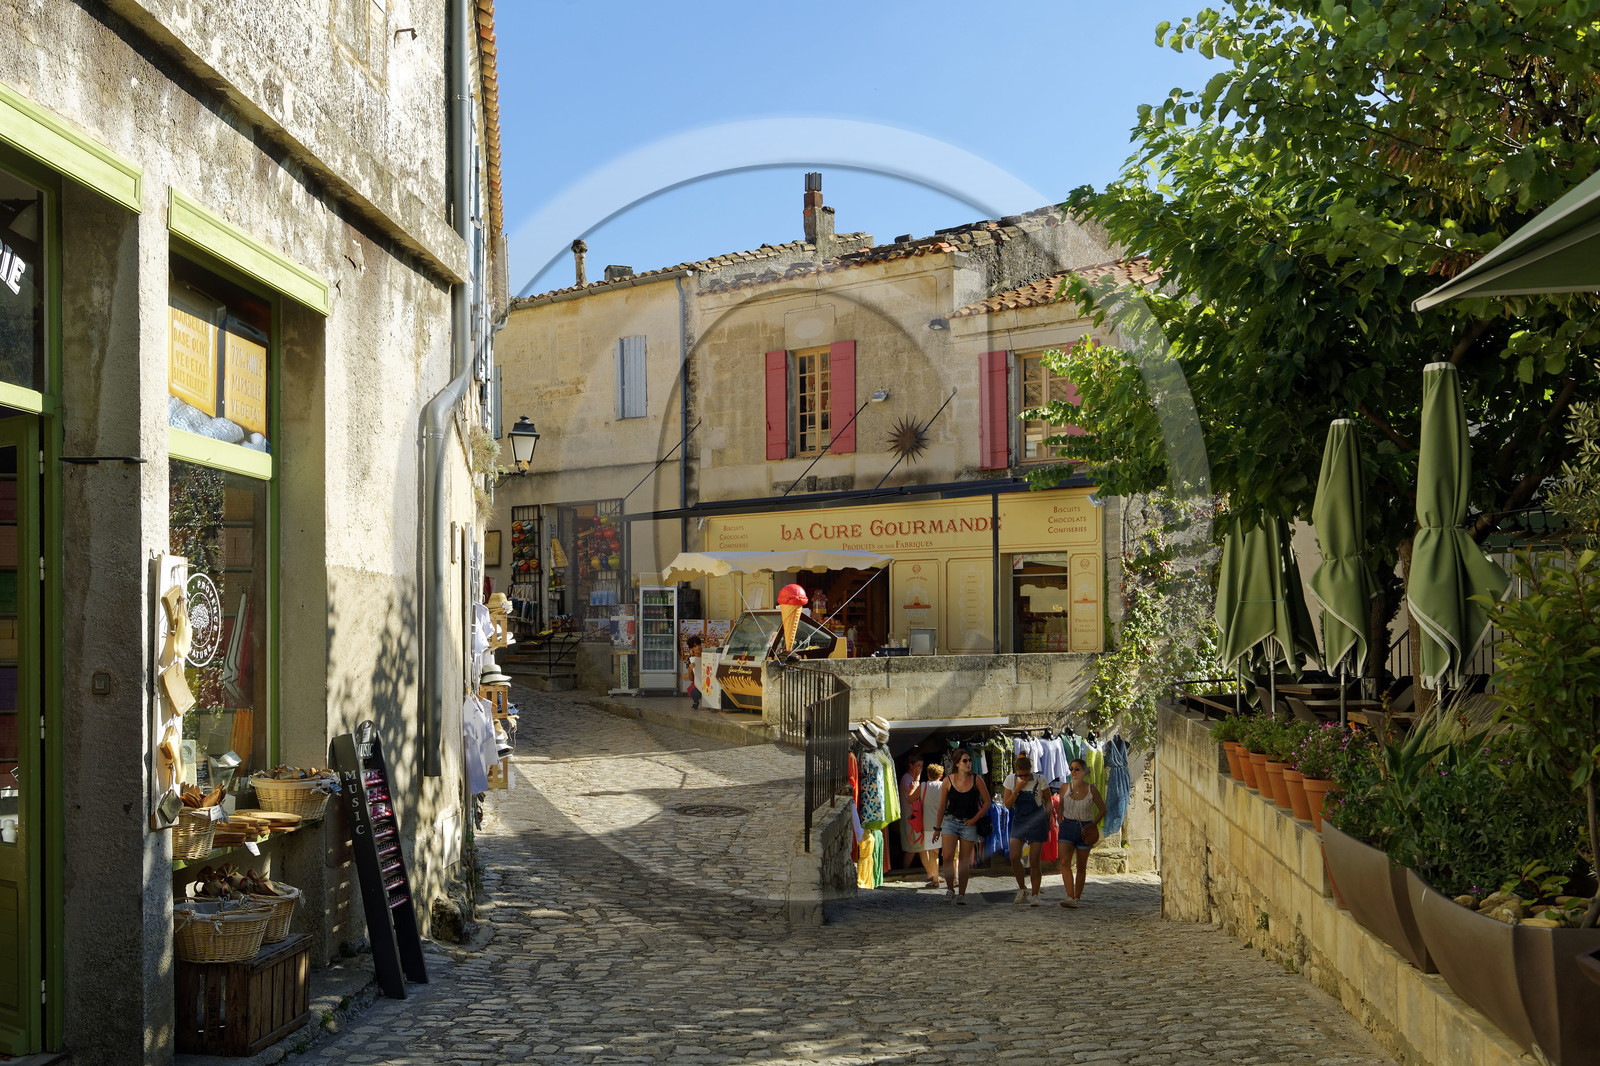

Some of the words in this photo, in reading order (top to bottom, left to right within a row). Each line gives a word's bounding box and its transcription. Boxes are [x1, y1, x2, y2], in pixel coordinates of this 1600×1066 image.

[1053, 506, 1081, 514] BISCUITS
[1047, 516, 1087, 524] CHOCOLATS
[780, 523, 805, 541] LA
[809, 521, 862, 540] CURE
[1047, 526, 1088, 534] CONFISERIES
[842, 542, 876, 551] PRODUITS
[895, 540, 934, 549] FABRIQUES
[197, 580, 218, 632] PROVENCE
[344, 770, 366, 836] MUSIC
